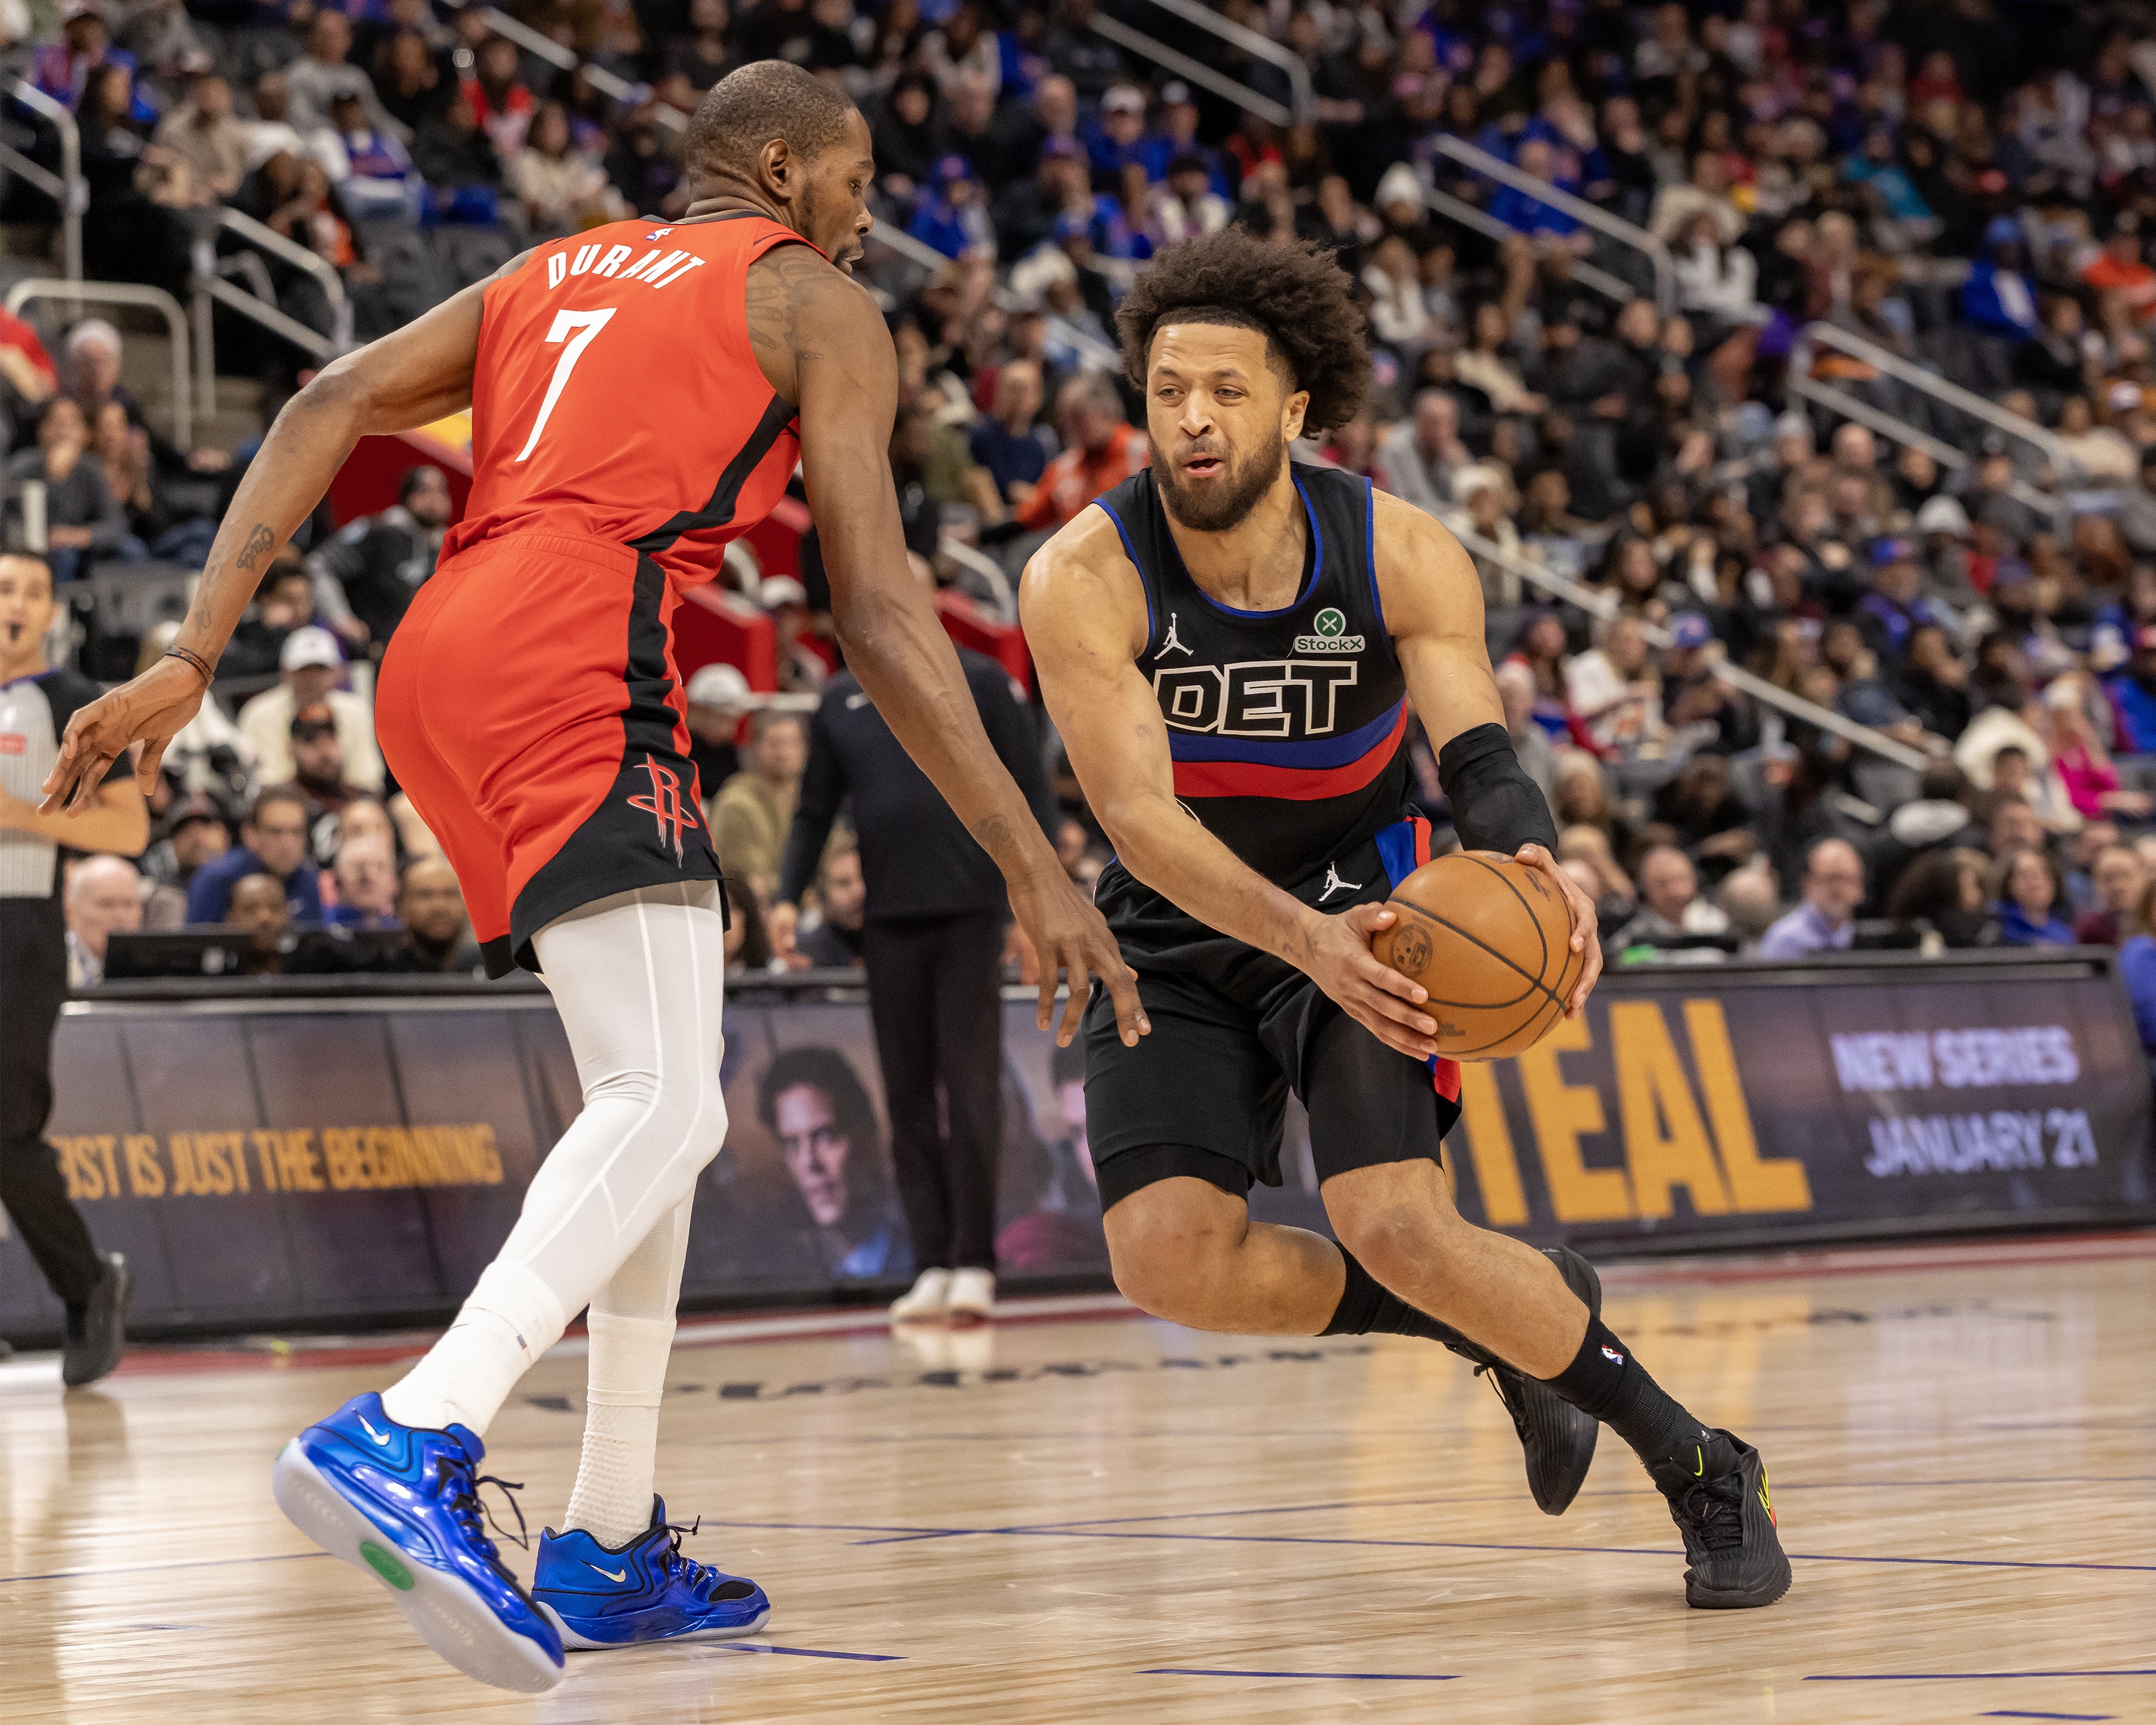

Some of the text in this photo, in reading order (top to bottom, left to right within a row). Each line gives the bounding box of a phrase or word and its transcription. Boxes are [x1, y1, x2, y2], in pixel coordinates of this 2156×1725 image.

[548, 244, 706, 290] DURANT
[514, 308, 617, 462] 7
[1297, 638, 1363, 651] StockX
[1153, 660, 1358, 737] DET
[1830, 1025, 2081, 1092] NEW SERIES
[1440, 998, 1813, 1225] TEAL
[1865, 1108, 2099, 1177] JANUARY 21
[123, 1133, 166, 1197] IS
[170, 1131, 249, 1196] JUST
[252, 1127, 323, 1192] THE
[324, 1123, 503, 1190] BEGINNING
